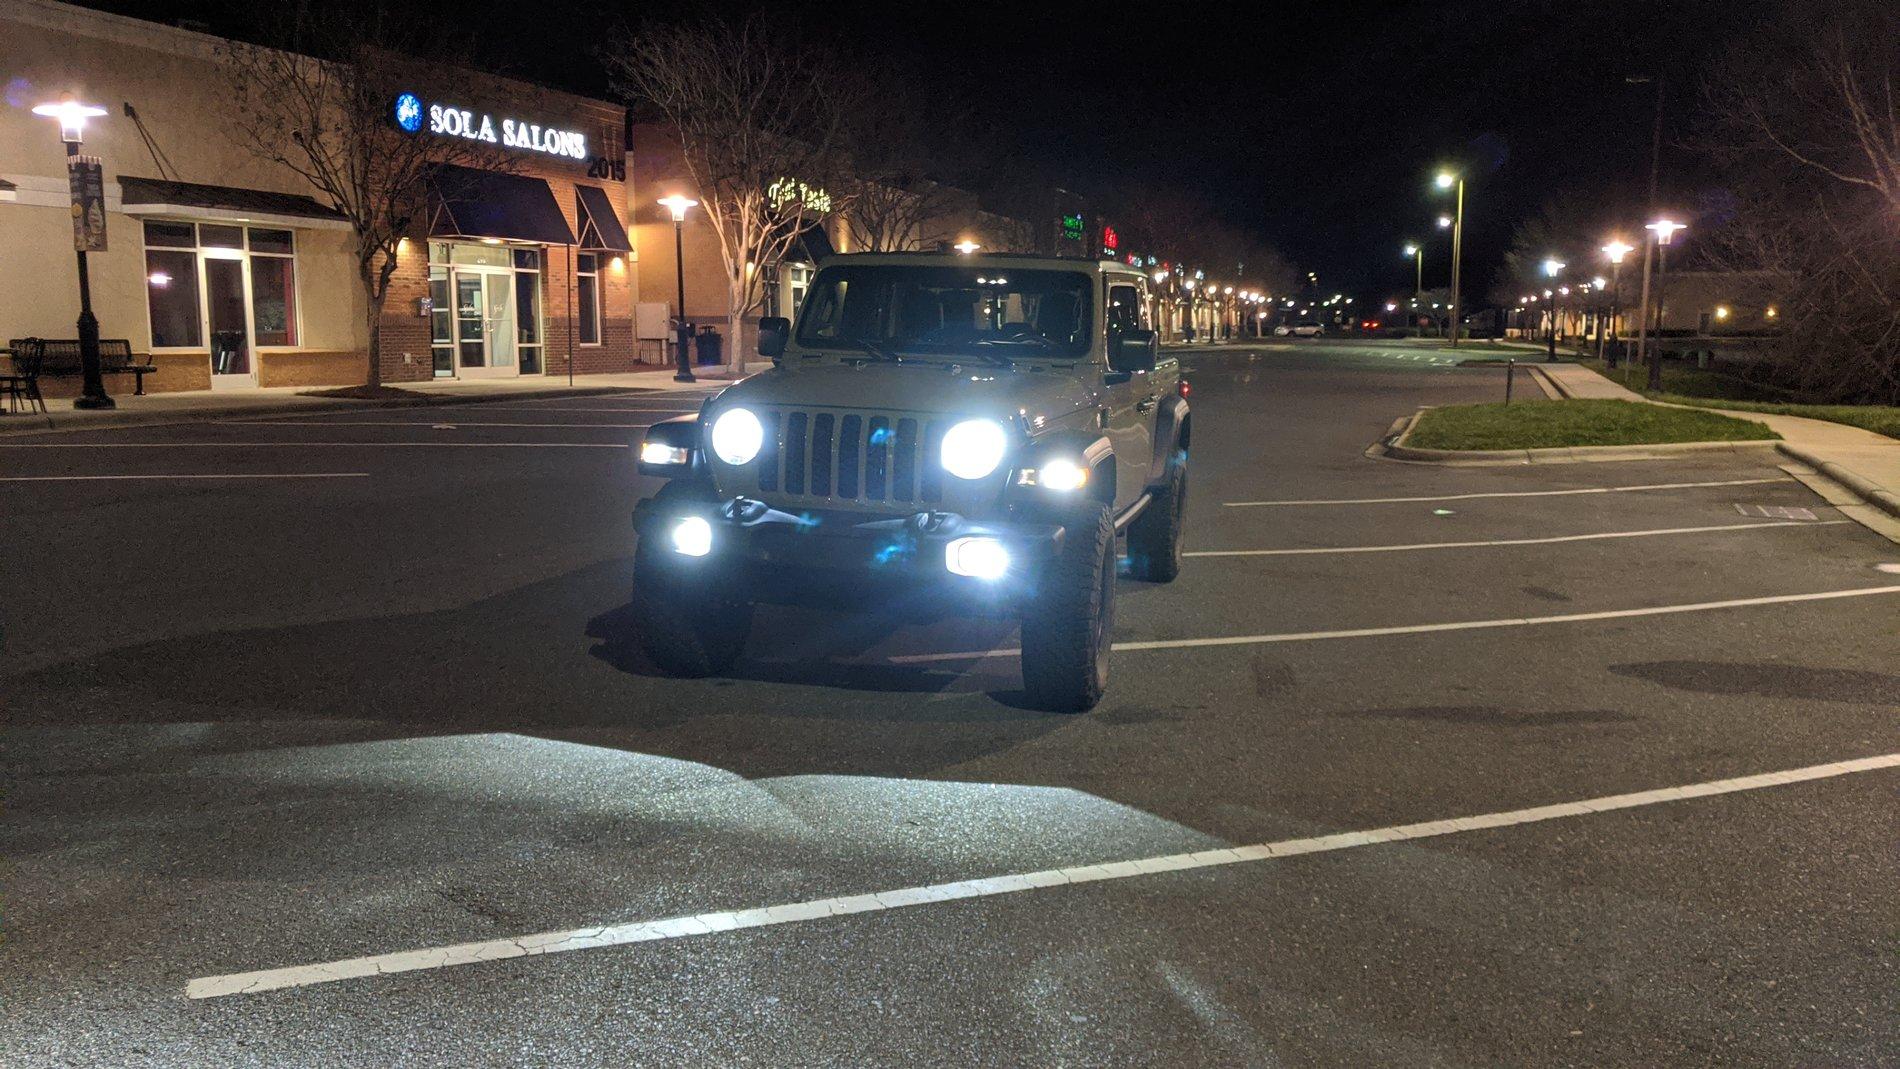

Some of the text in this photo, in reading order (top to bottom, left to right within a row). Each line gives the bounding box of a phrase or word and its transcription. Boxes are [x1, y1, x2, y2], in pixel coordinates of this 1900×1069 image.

[430, 104, 586, 159] SOLA SALONS
[587, 157, 626, 182] 2015
